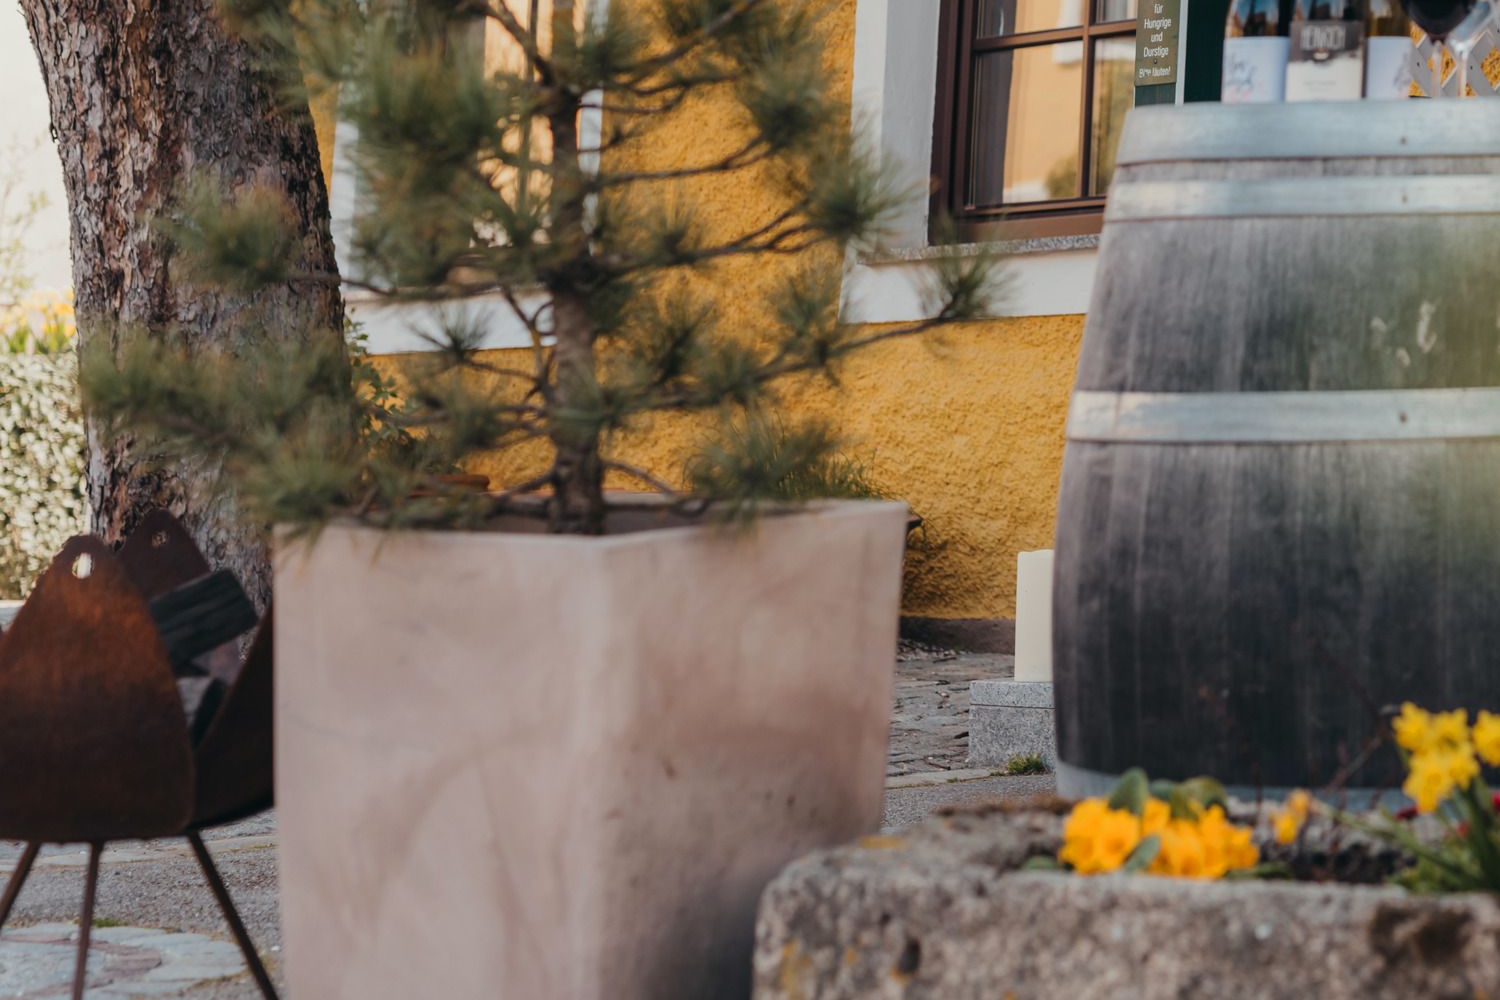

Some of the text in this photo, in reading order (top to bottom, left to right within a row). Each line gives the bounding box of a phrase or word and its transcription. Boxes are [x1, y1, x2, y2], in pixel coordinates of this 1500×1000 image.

[1154, 3, 1164, 14] für
[1143, 17, 1172, 30] Hungrige
[1150, 31, 1164, 42] und
[1143, 46, 1169, 58] Durstige
